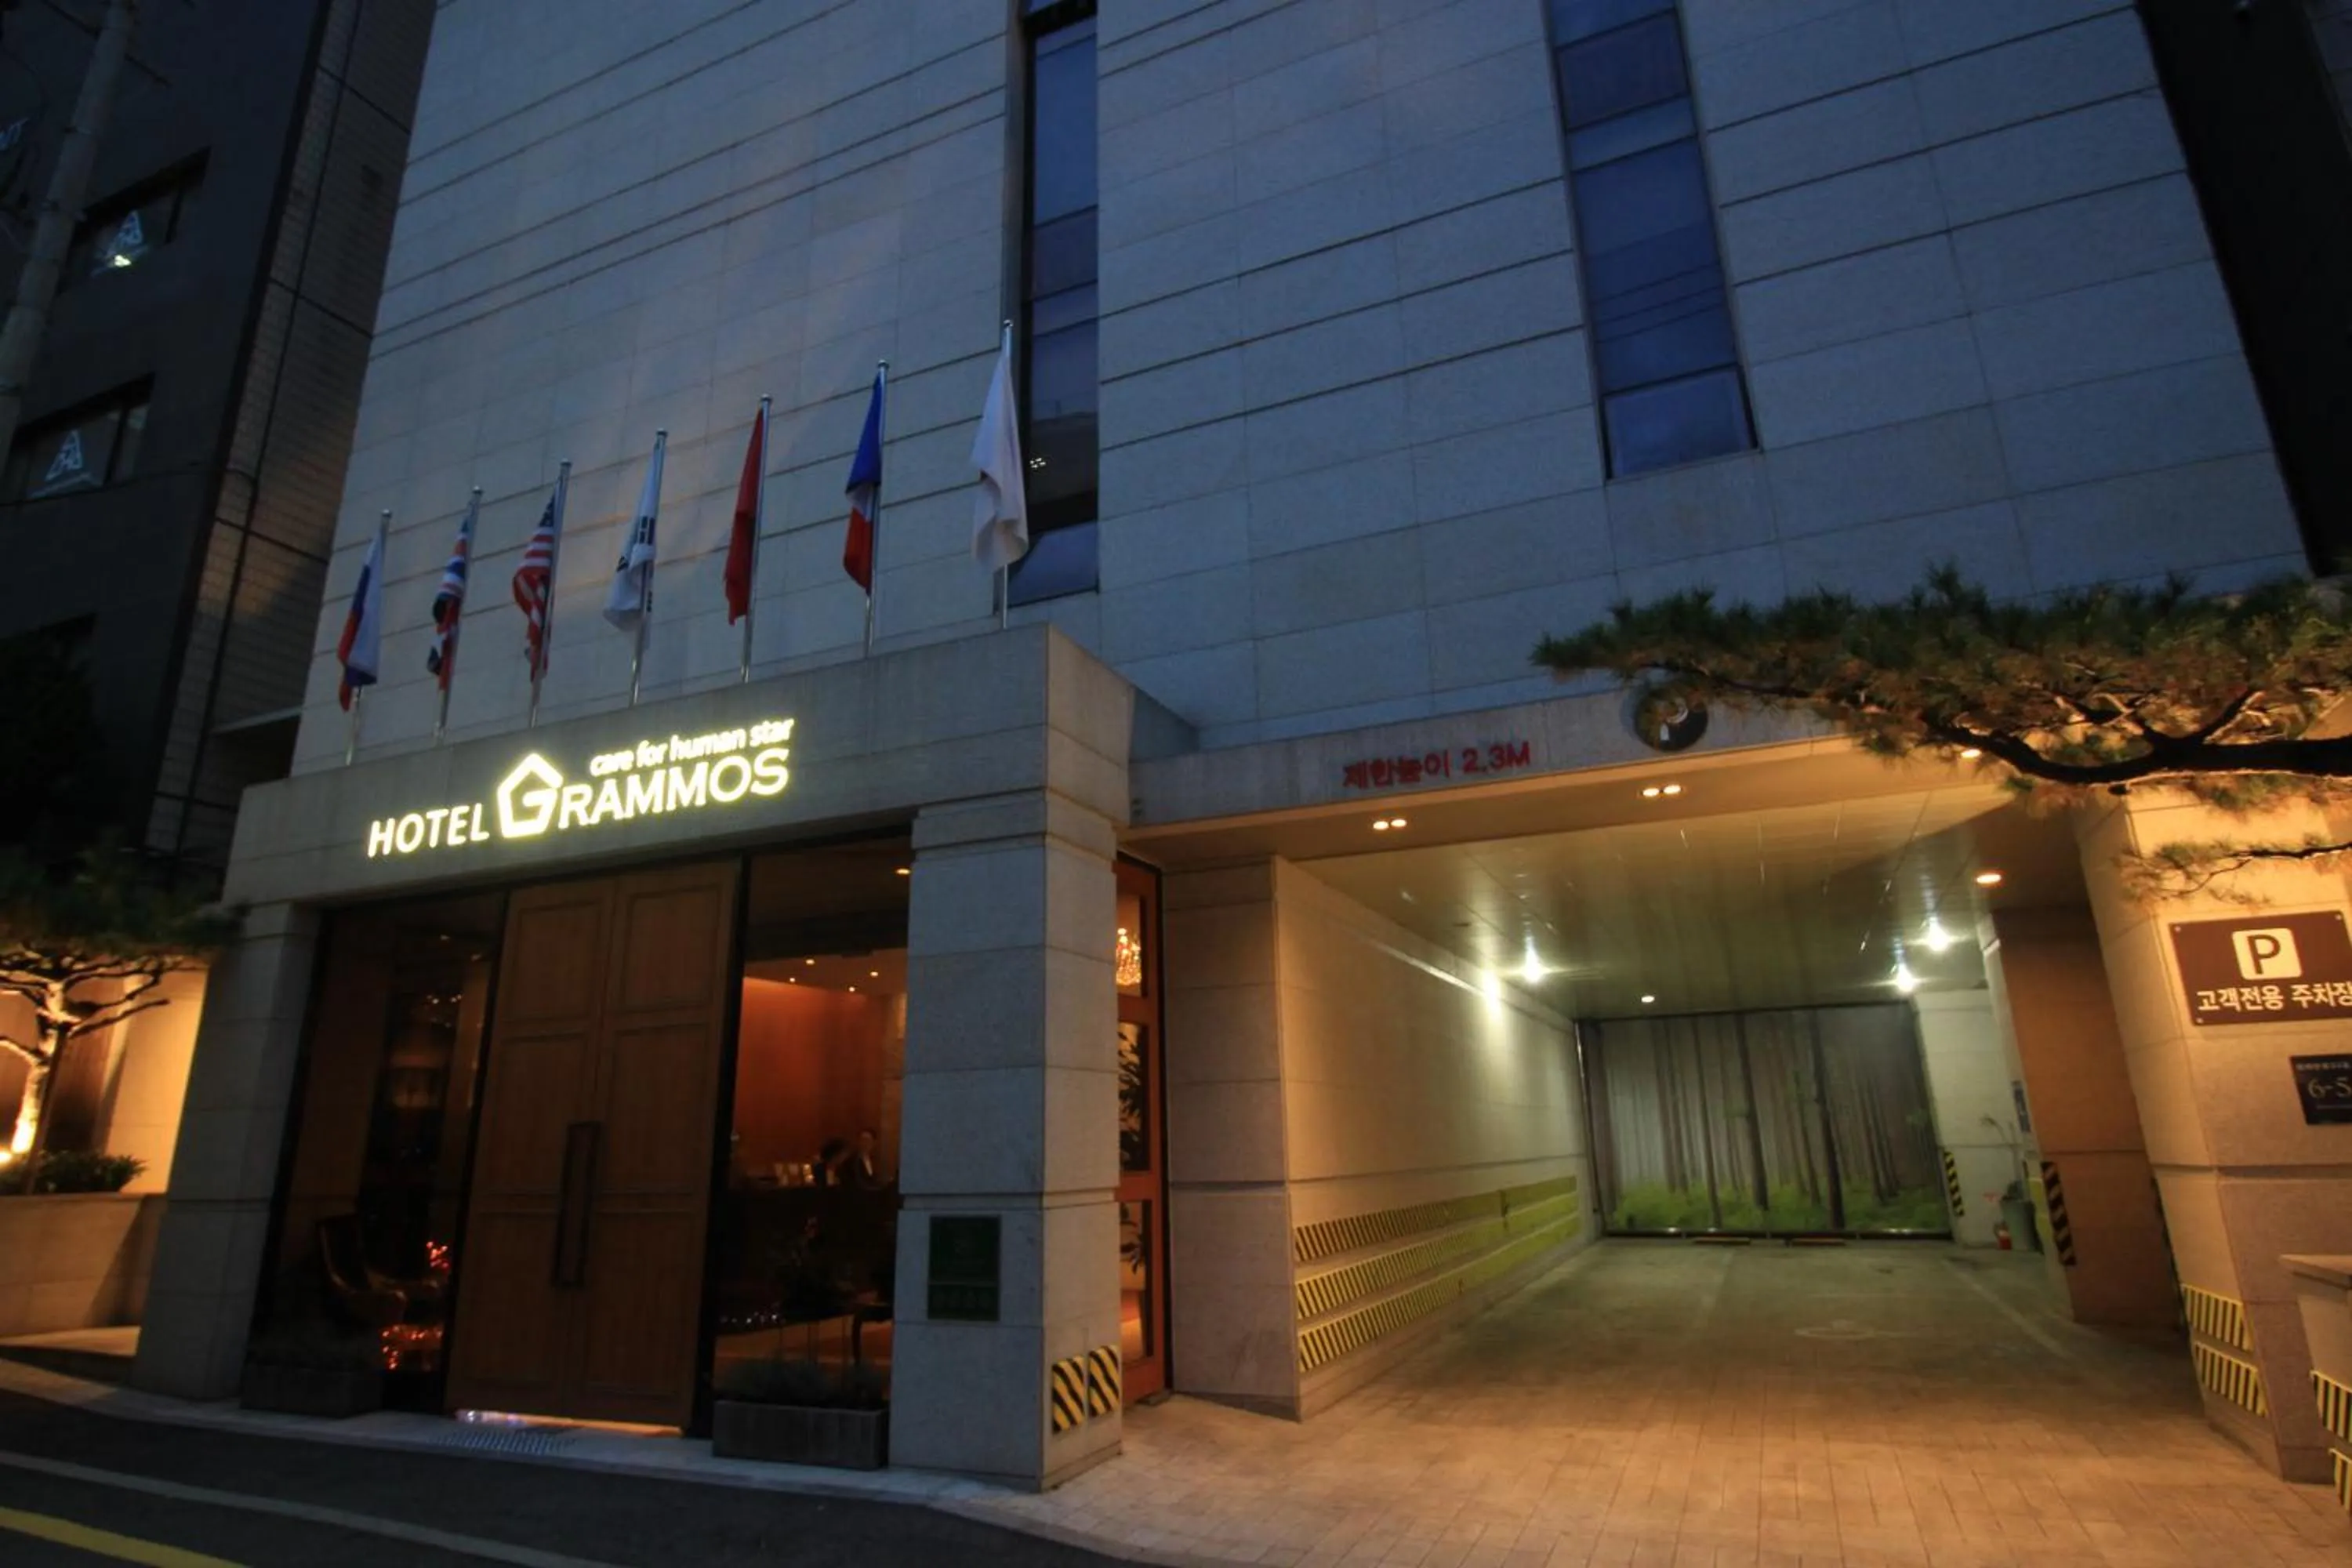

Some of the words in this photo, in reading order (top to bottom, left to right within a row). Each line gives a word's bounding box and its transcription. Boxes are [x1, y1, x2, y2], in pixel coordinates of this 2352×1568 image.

[590, 750, 633, 777] care
[637, 740, 668, 768] for
[670, 728, 746, 761] human
[1462, 742, 1530, 773] 2.3M
[368, 804, 489, 858] HOTEL
[496, 748, 789, 839] GRAMMOS
[2247, 934, 2281, 975] P
[2196, 985, 2285, 1011] 고객전용
